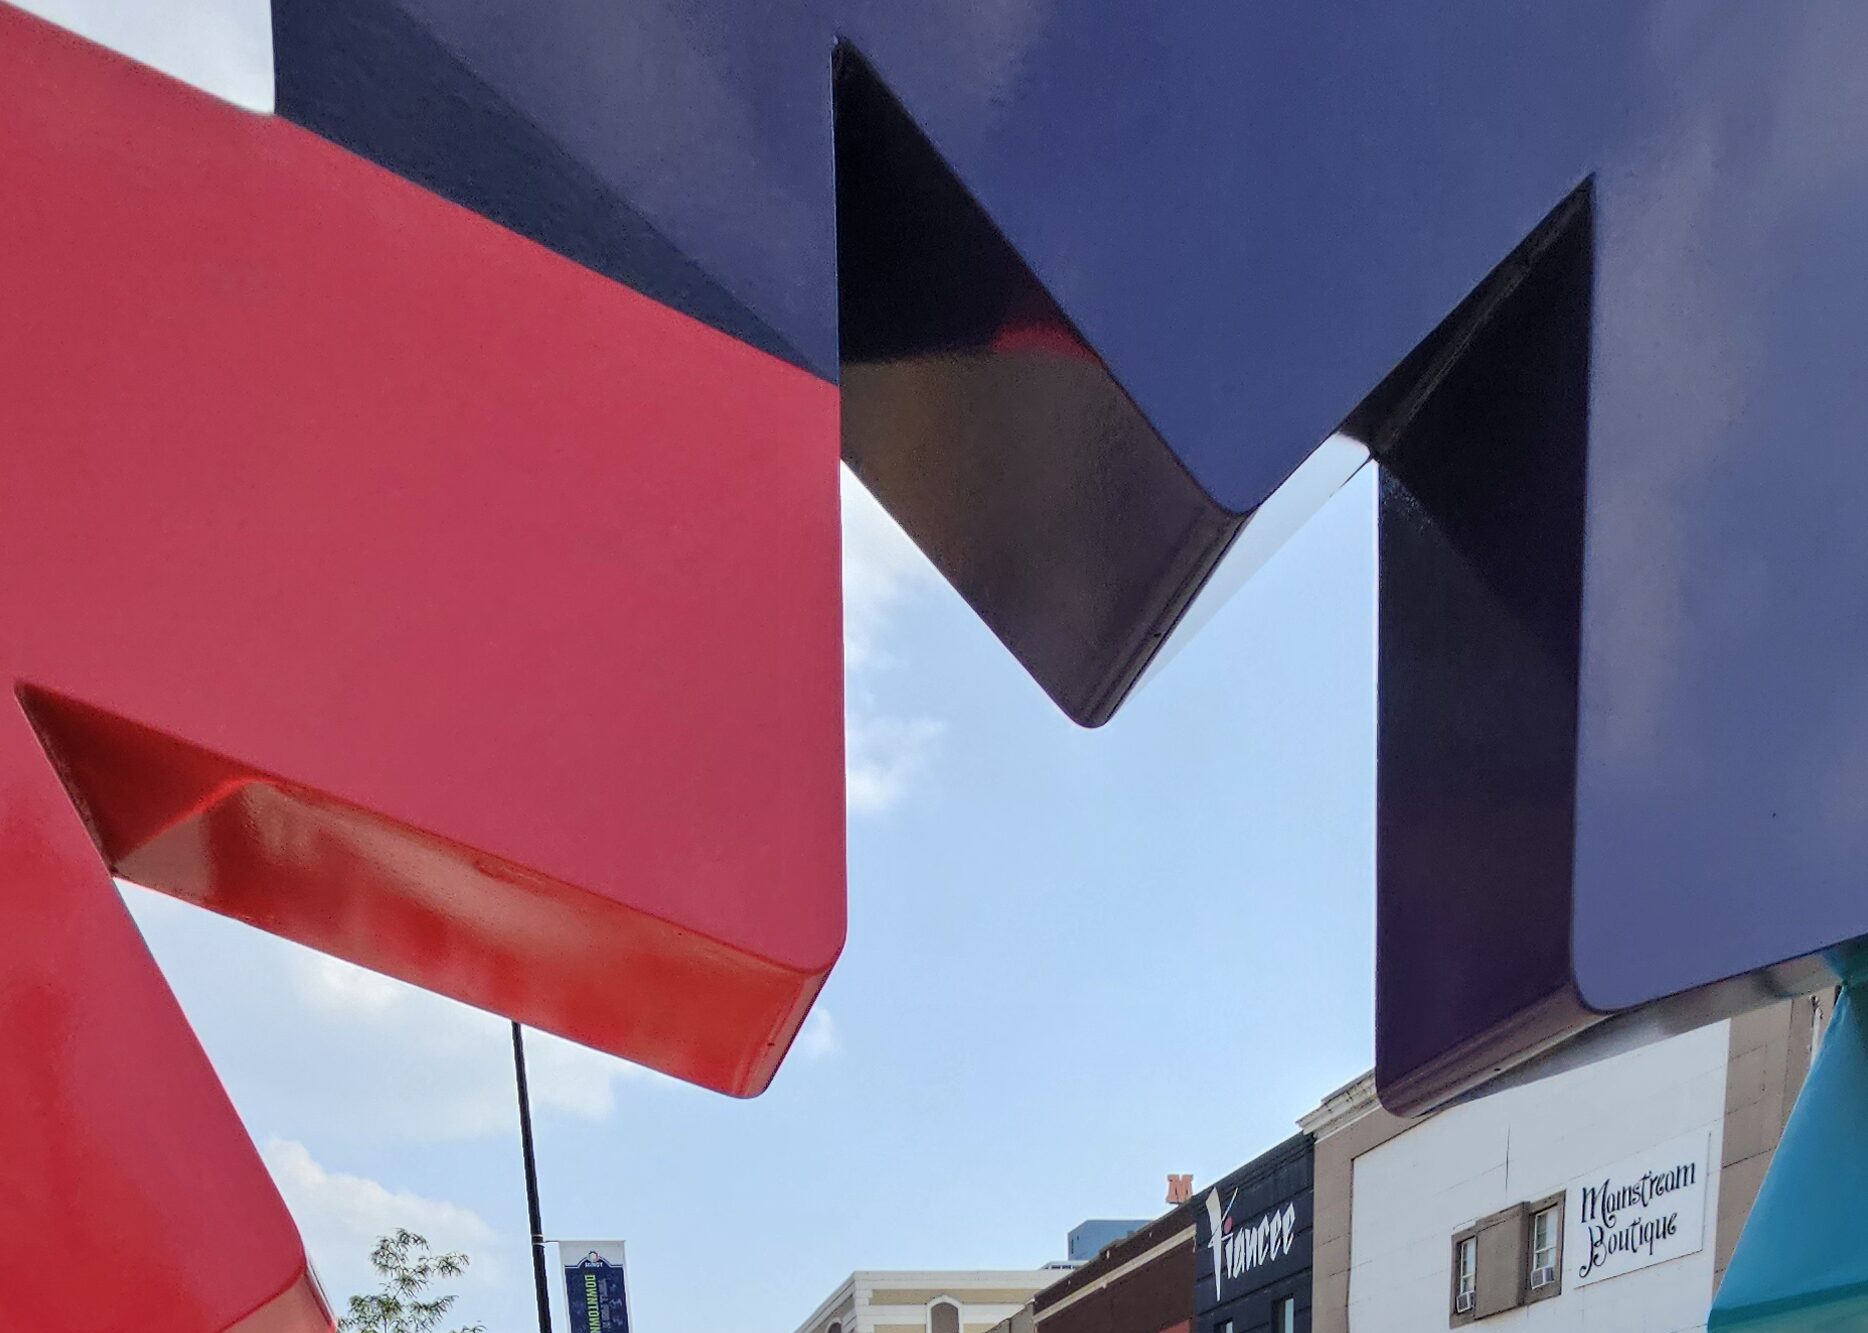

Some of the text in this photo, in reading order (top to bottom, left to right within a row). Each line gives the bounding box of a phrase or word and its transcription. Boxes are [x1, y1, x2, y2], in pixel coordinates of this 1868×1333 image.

[1581, 1162, 1696, 1229] Mainstream
[1205, 1186, 1296, 1302] Fiancee
[1578, 1212, 1678, 1279] Boutique
[584, 1274, 602, 1333] DOWNTOWN
